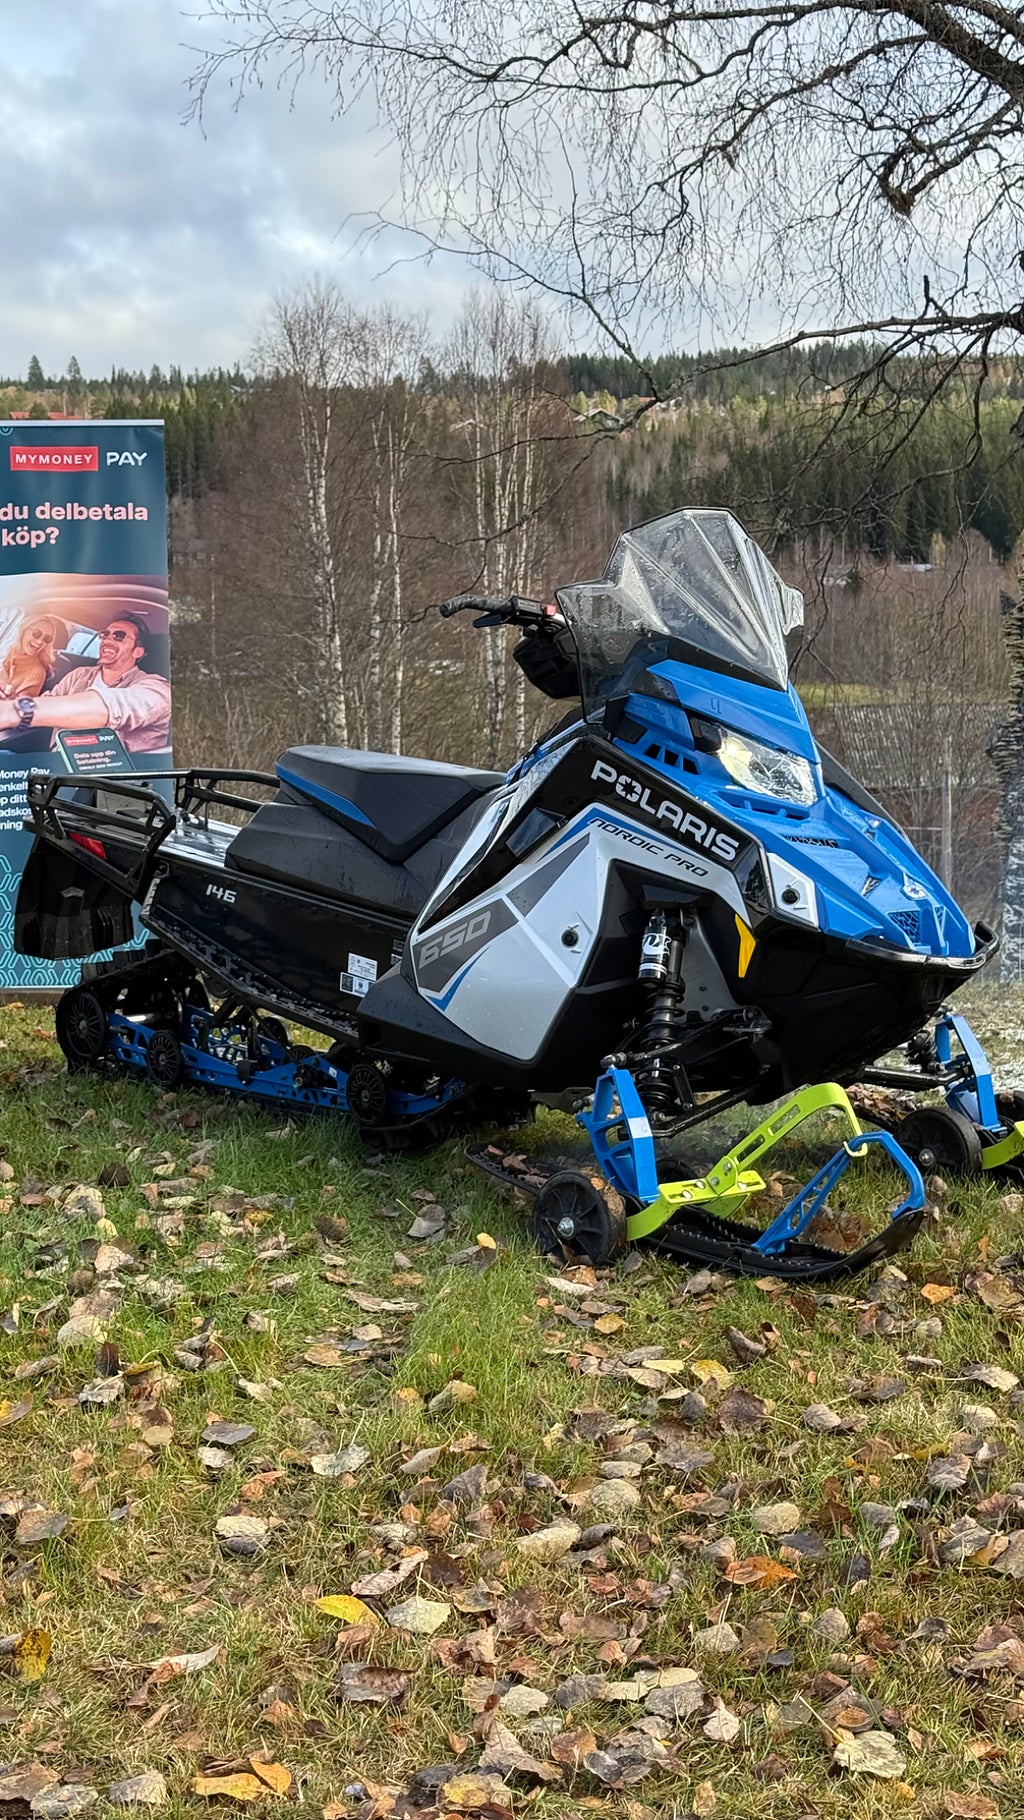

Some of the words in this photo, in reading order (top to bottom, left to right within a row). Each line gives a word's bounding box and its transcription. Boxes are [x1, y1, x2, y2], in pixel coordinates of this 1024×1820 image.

[15, 454, 93, 465] MYMONEY
[106, 451, 148, 466] PAY
[0, 502, 29, 521] du
[35, 502, 149, 521] delbetala
[1, 525, 60, 549] köp?
[590, 760, 740, 861] POLARIS
[590, 817, 664, 856] NORDIC
[664, 853, 709, 877] PRO
[205, 883, 238, 904] 146
[418, 910, 492, 970] 650
